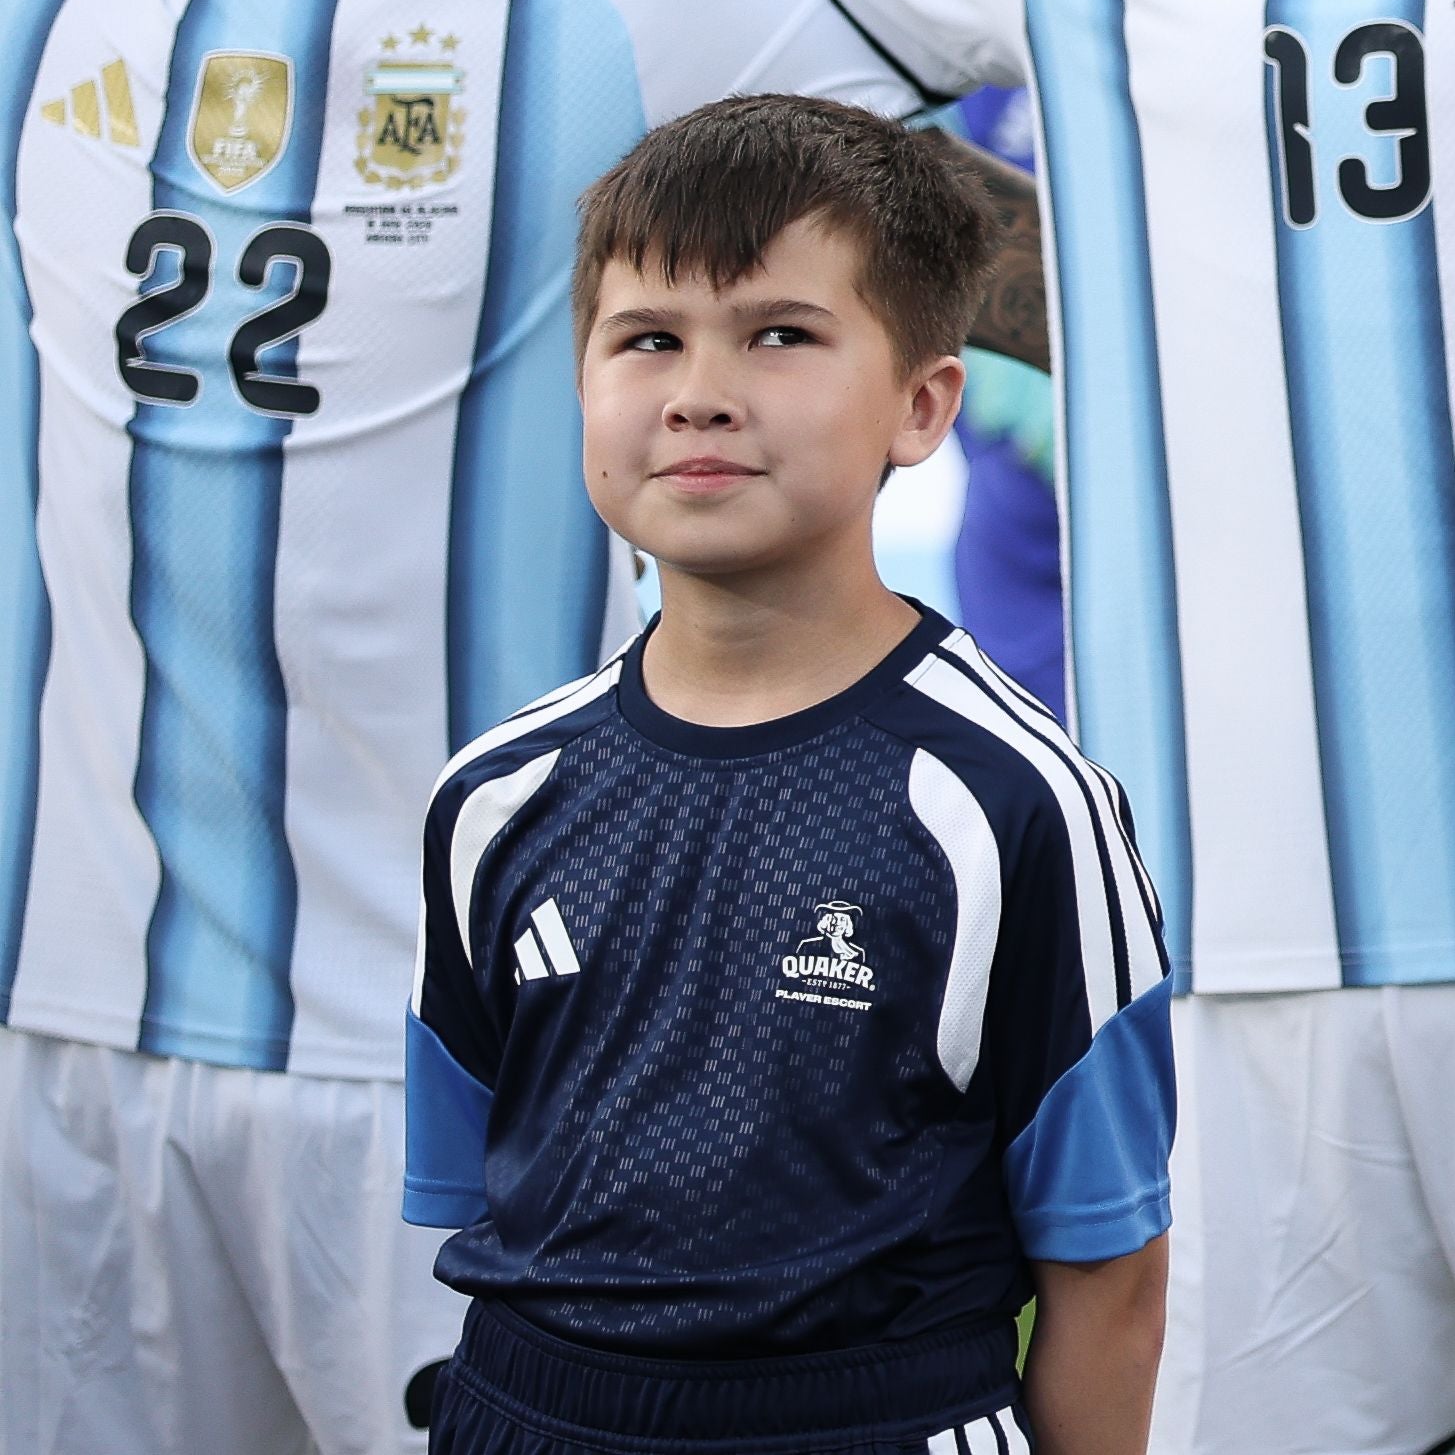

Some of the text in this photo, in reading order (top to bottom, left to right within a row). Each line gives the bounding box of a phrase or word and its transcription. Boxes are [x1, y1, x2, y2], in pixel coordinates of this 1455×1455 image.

[377, 96, 440, 156] AFA
[1263, 21, 1432, 227] 13
[112, 209, 334, 418] 22
[775, 989, 873, 1011] PLAYER ESCORT
[781, 955, 874, 989] QUAKER
